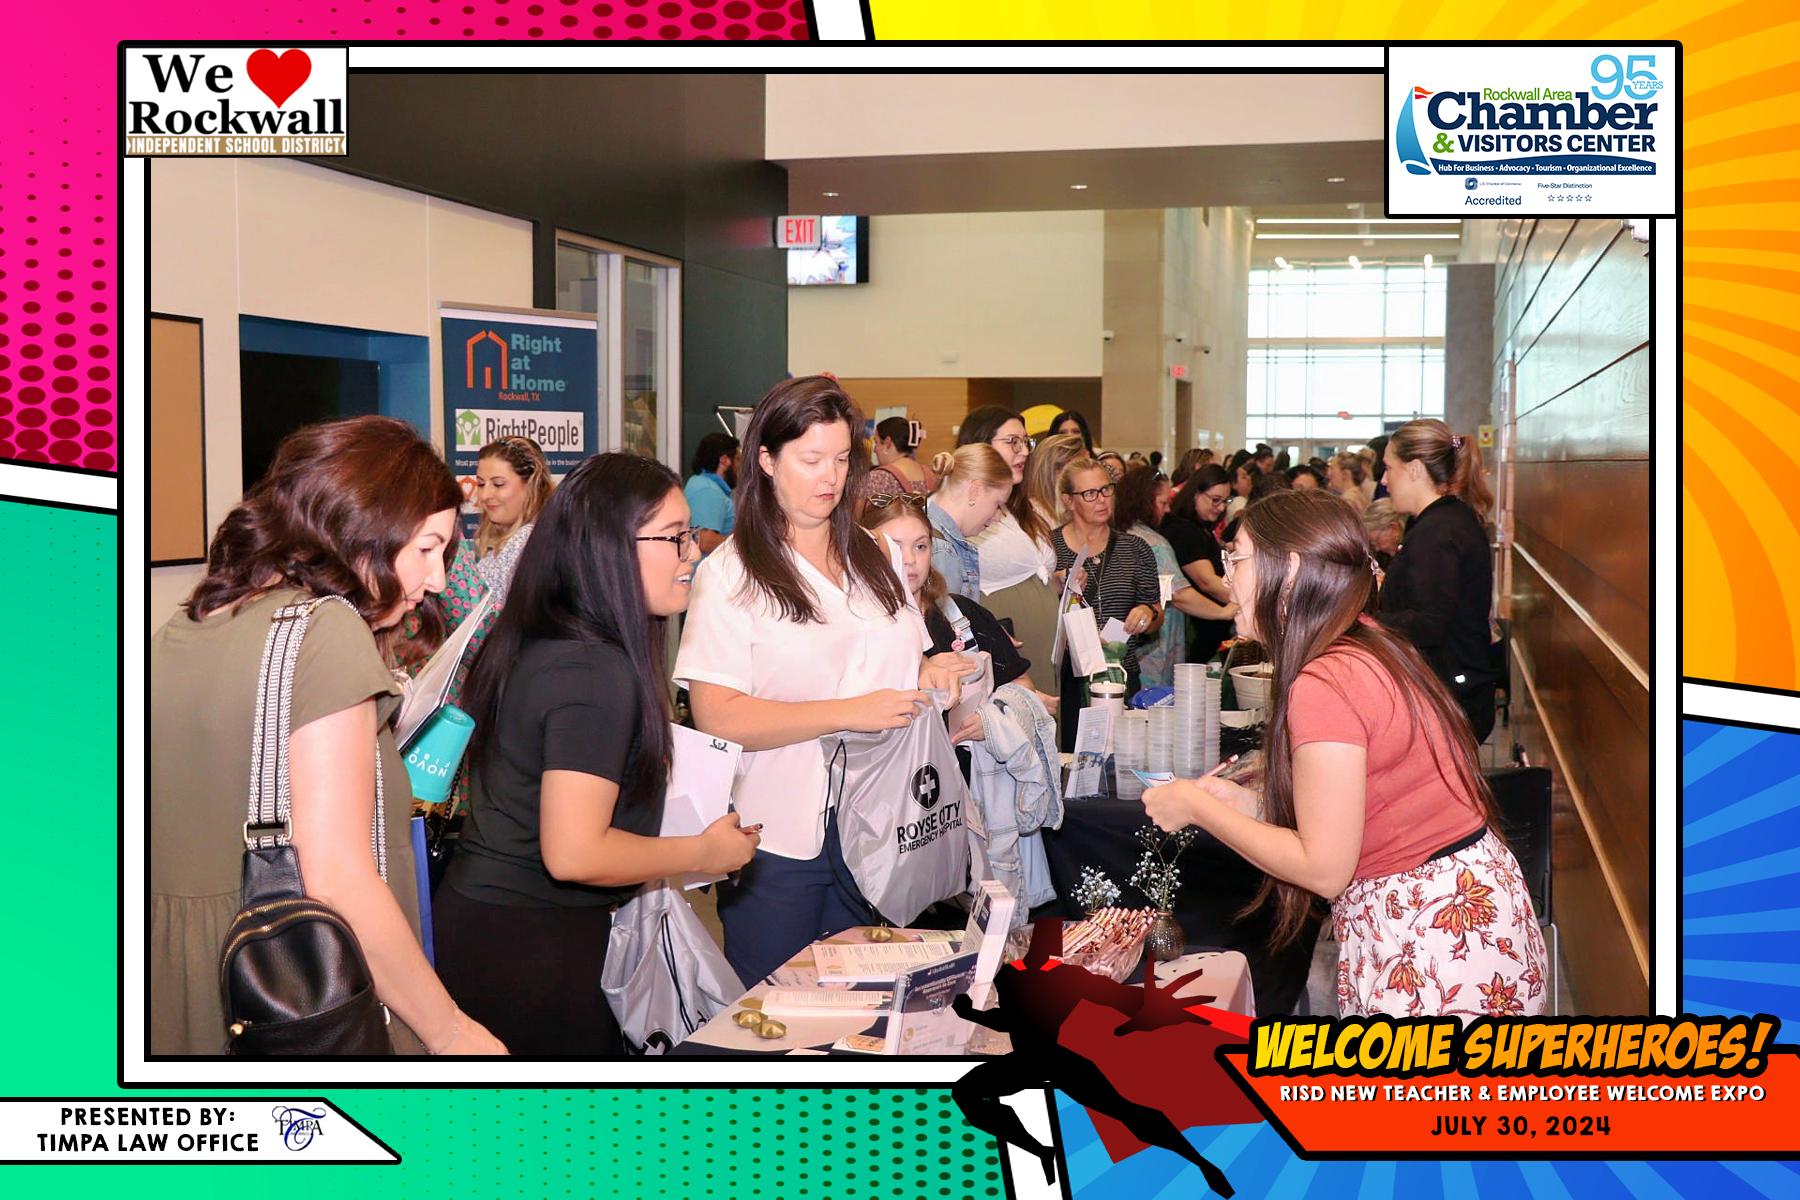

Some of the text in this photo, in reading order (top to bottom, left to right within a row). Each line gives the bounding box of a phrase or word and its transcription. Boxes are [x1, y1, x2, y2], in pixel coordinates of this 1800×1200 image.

[784, 218, 815, 244] EXIT
[511, 333, 562, 355] Right
[510, 355, 531, 371] at
[511, 374, 567, 392] Home
[485, 418, 579, 450] RightPeople
[408, 754, 448, 777] NOVO
[896, 800, 961, 844] ROYSE CITY
[899, 818, 963, 854] EMERGENCY HSPITAL
